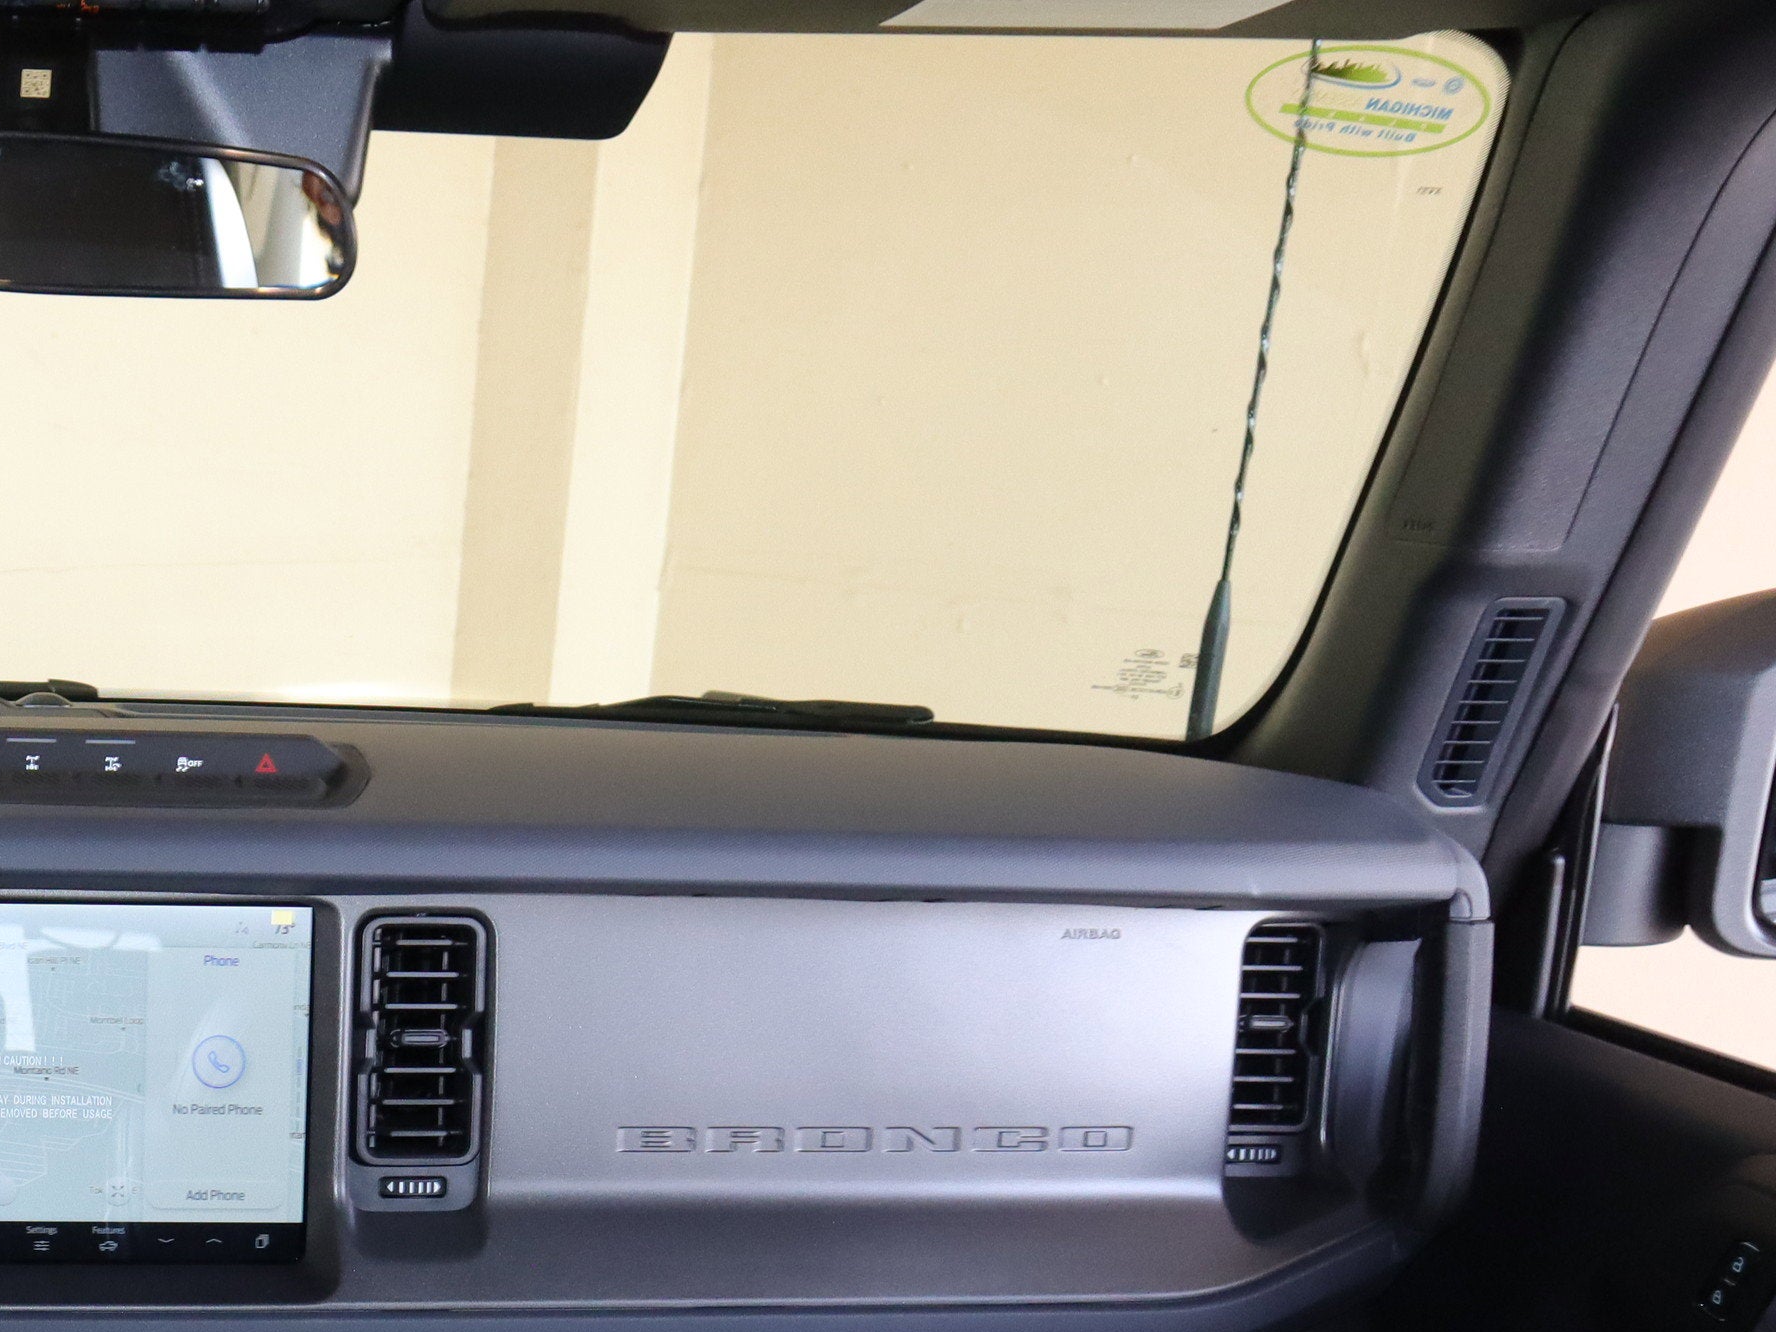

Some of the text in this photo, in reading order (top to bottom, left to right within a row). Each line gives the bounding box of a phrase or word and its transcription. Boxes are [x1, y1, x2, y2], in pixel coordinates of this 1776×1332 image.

[187, 760, 203, 768] OFF
[1061, 927, 1122, 941] AIRBAG
[203, 954, 240, 967] Phone
[67, 1066, 79, 1075] NE
[13, 1094, 46, 1106] DURING
[51, 1095, 113, 1106] INSTALLATION
[42, 1108, 78, 1119] BEFORE
[82, 1108, 113, 1120] USAGE
[173, 1104, 263, 1116] No Paired Phone
[615, 1124, 1135, 1154] BRONCO
[186, 1190, 246, 1201] Add Phone
[25, 1225, 58, 1236] Settings
[91, 1225, 126, 1236] Features
